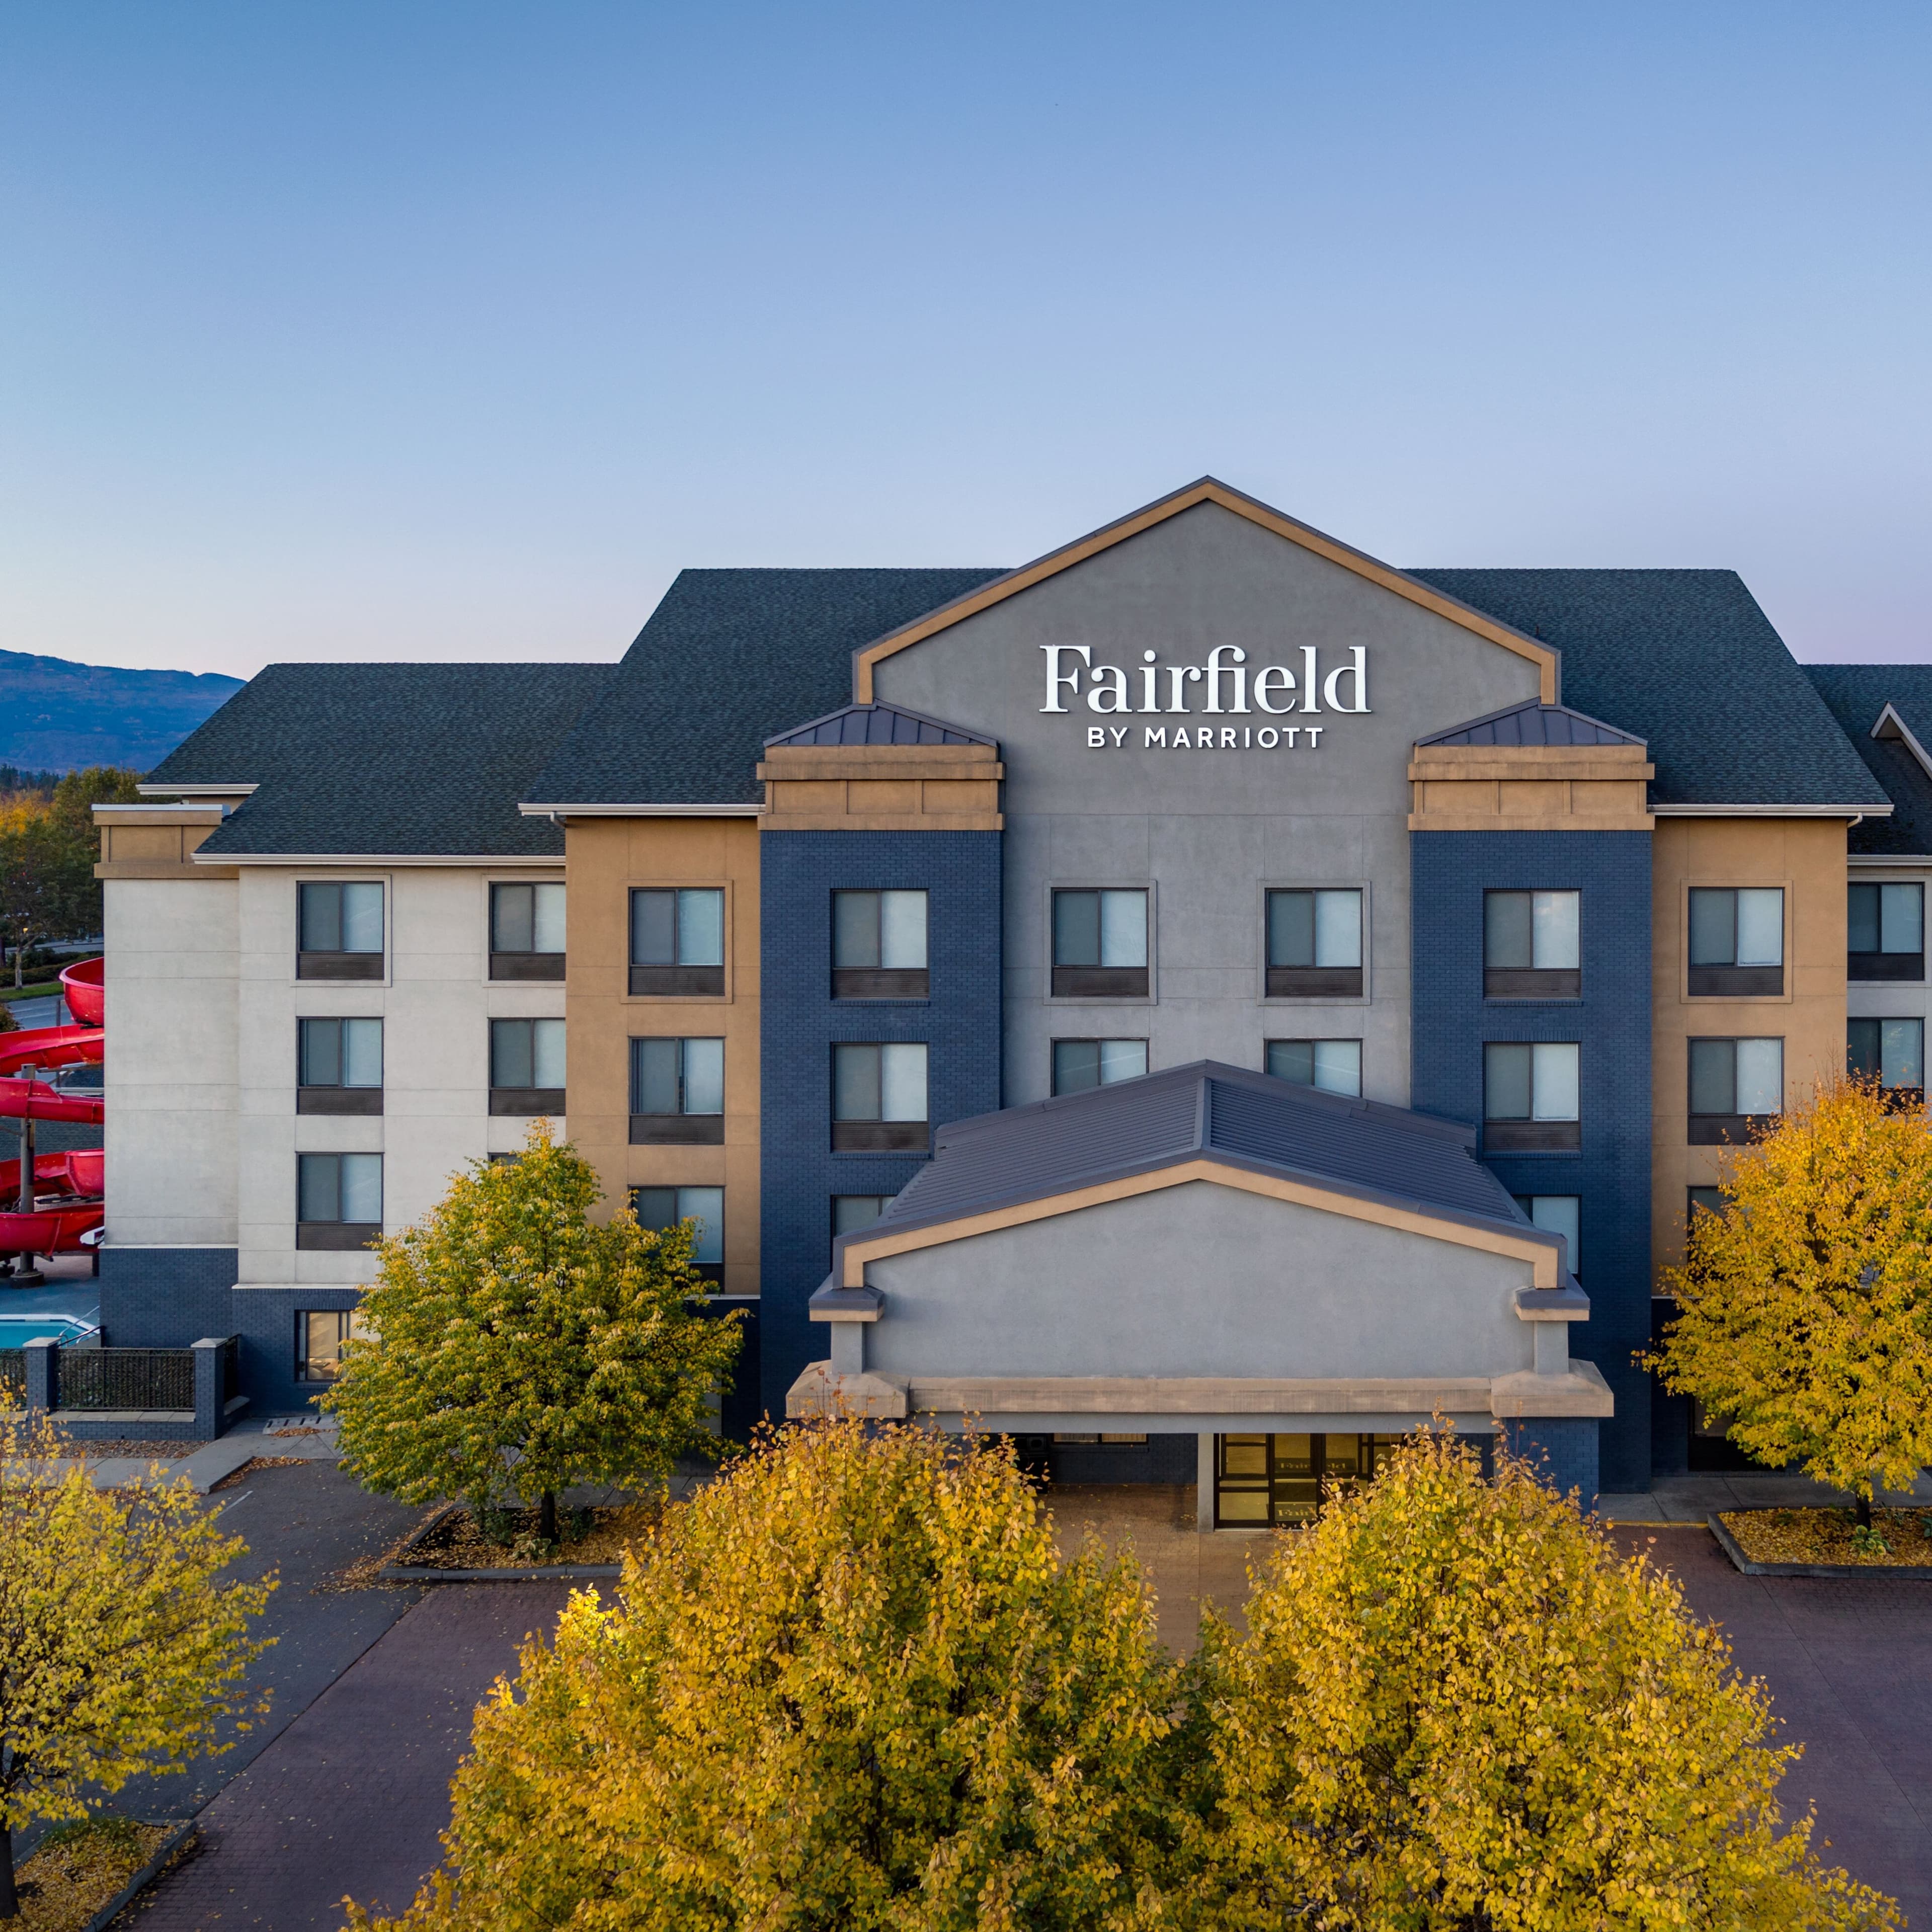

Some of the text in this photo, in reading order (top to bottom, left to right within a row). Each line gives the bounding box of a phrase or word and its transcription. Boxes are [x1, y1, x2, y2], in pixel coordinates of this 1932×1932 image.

[1039, 645, 1371, 713] Fairfield
[1088, 727, 1323, 748] BY MARRIOTT
